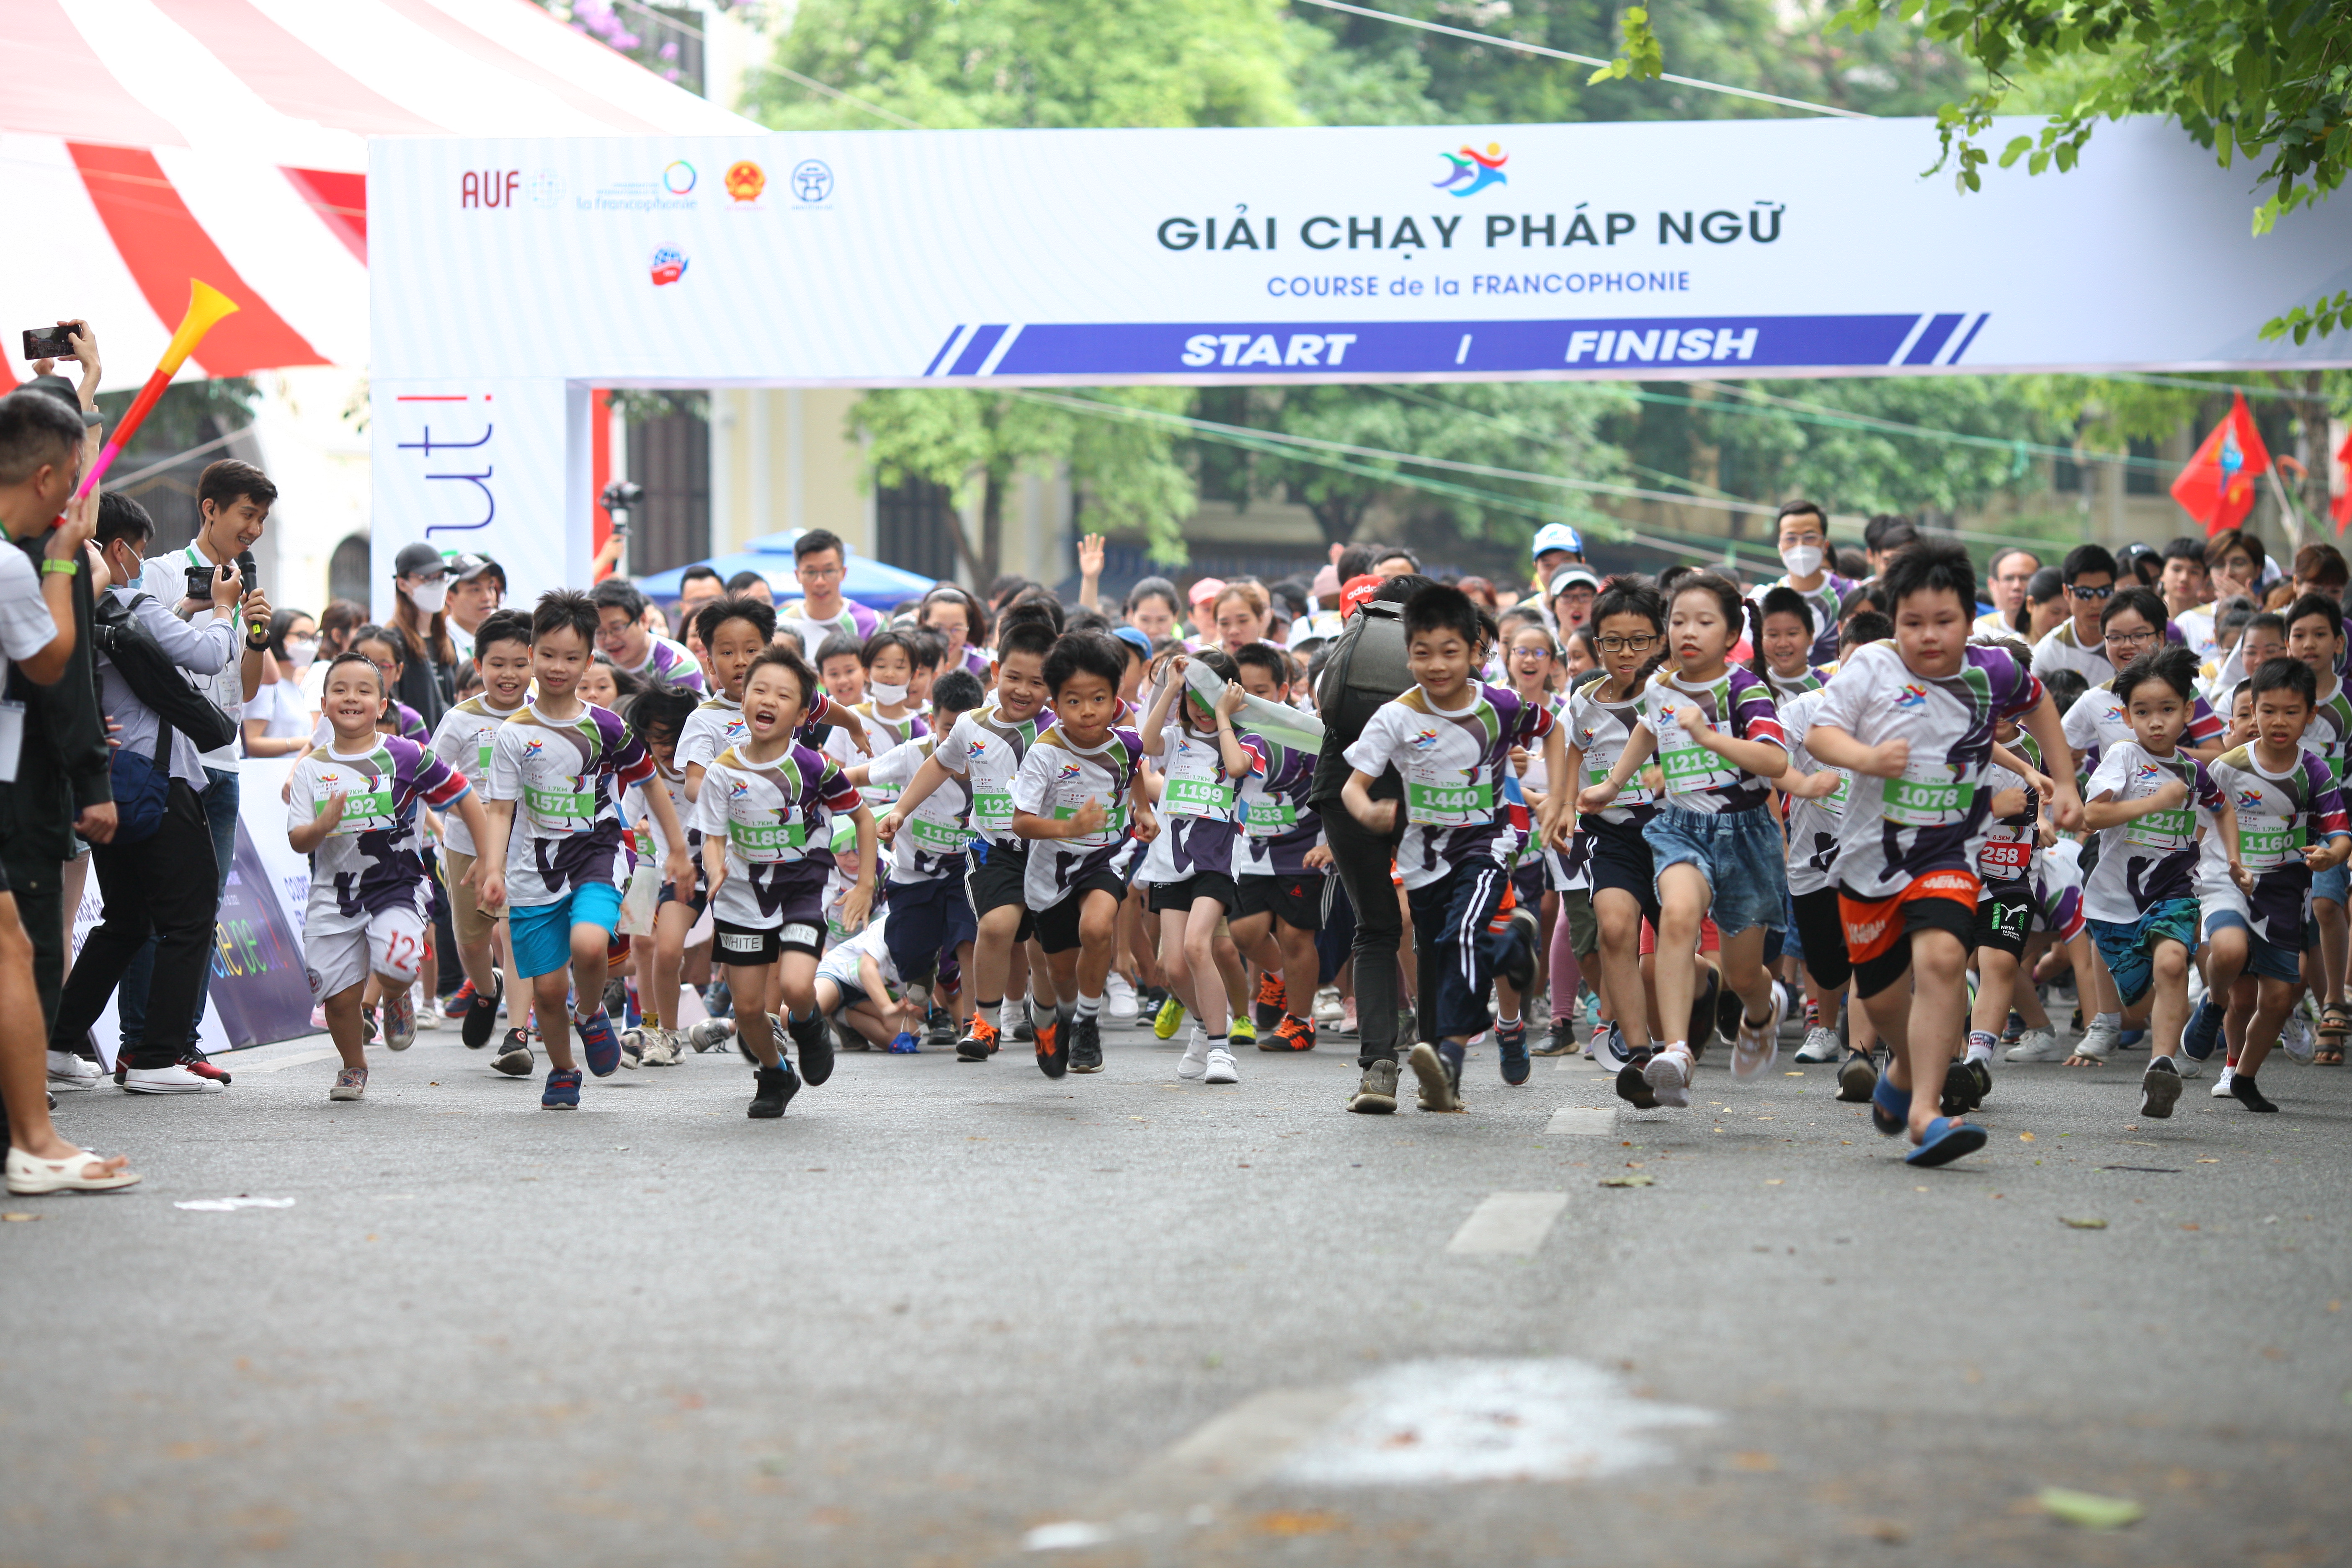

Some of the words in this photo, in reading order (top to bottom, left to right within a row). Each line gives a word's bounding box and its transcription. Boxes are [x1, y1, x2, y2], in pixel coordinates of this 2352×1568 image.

[462, 171, 519, 209] AUF
[1157, 204, 1277, 250] GIẢI
[1300, 214, 1462, 259] CHẠY
[1486, 202, 1636, 248] PHÁP
[1658, 201, 1786, 244] NGỮ
[1266, 276, 1379, 297] COURSE
[1389, 275, 1424, 296] de
[1434, 275, 1460, 296] la
[1473, 271, 1690, 294] FRANCOPHONIE
[1181, 334, 1357, 366] START
[1564, 328, 1759, 363] FINISH
[397, 392, 494, 541] ut!
[1347, 584, 1377, 600] adid
[1667, 750, 1720, 775] 1213
[1177, 783, 1223, 802] 1199
[1422, 789, 1479, 808] 1440
[1896, 785, 1960, 808] 1078
[343, 797, 377, 817] 092
[531, 792, 579, 813] 1571
[983, 798, 1016, 814] 123
[1248, 807, 1283, 822] 1233
[2136, 812, 2186, 831] 1214
[738, 828, 790, 847] 1188
[922, 826, 967, 843] 1196
[2245, 834, 2294, 851] 1160
[1981, 846, 2019, 864] 258
[385, 929, 416, 972] 12
[722, 934, 760, 949] WHITE
